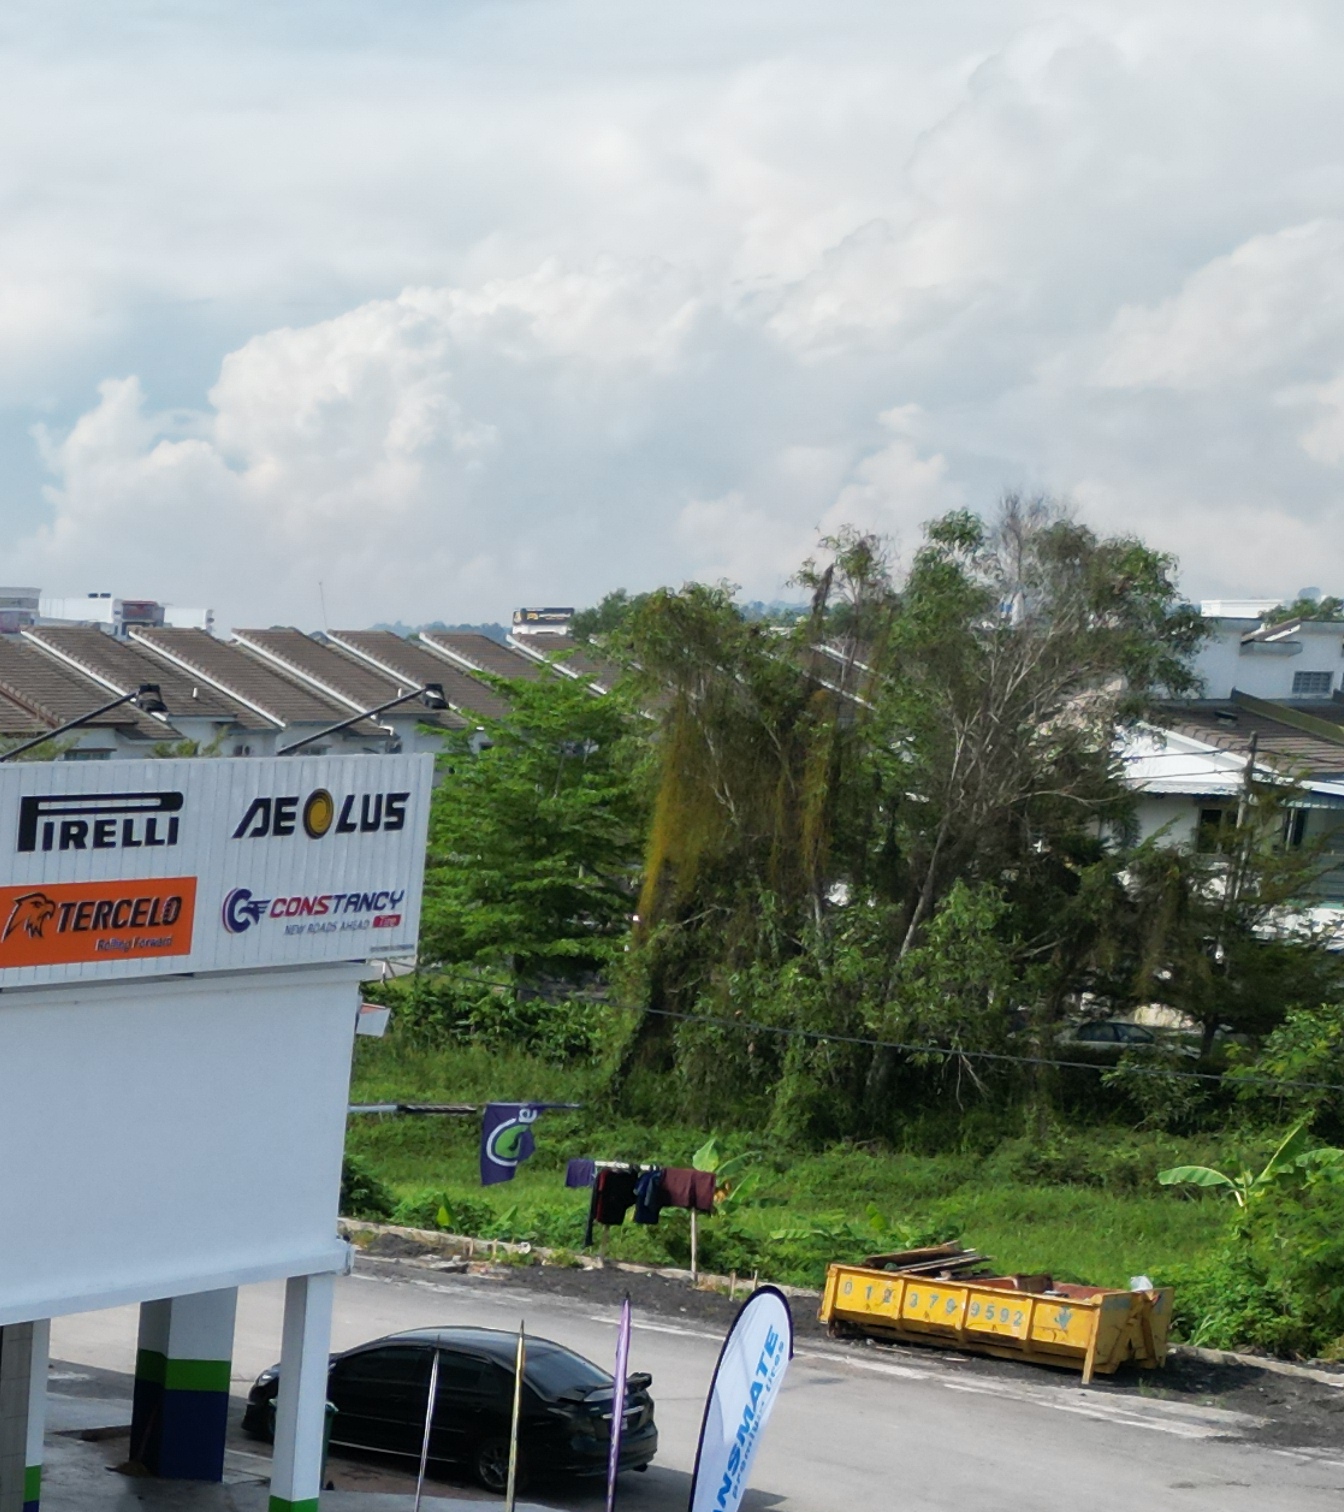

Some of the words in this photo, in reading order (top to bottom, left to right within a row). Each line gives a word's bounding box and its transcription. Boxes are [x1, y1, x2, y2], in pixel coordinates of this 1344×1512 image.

[17, 791, 184, 852] PIRELLI
[231, 788, 411, 839] AEOLUS
[57, 896, 182, 933] TERCELO
[269, 890, 405, 918] CONSTANCY
